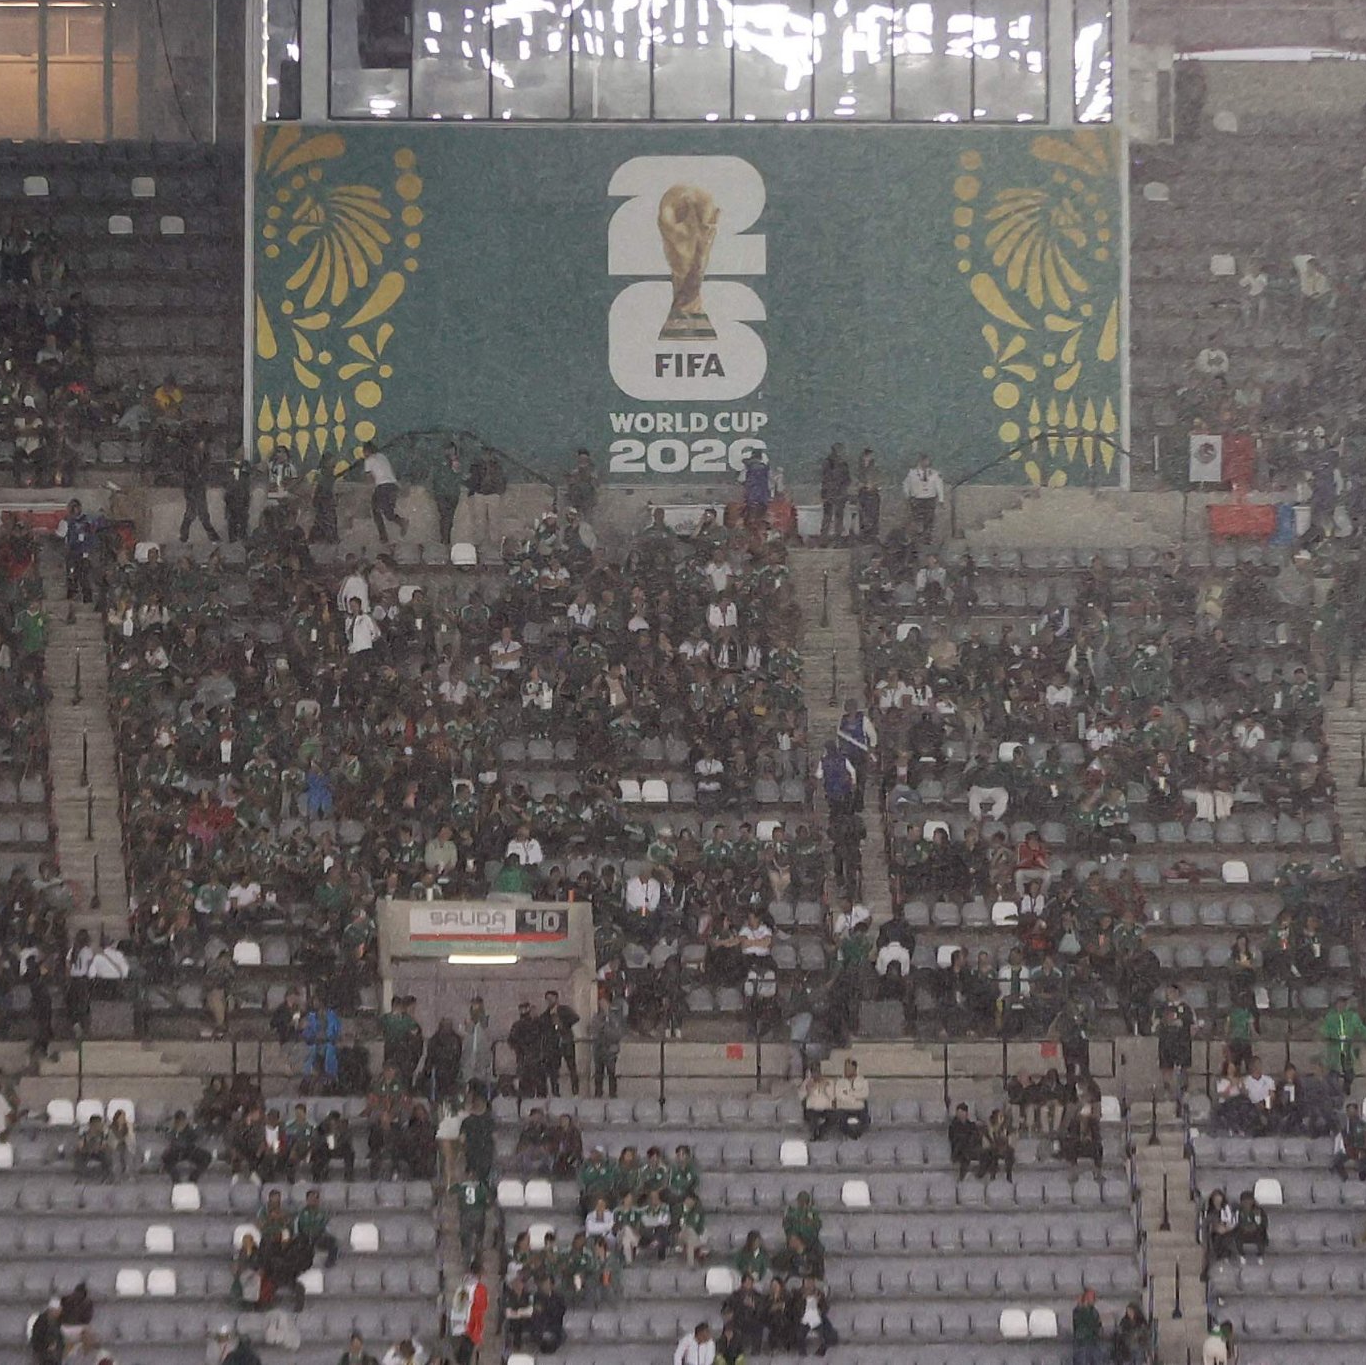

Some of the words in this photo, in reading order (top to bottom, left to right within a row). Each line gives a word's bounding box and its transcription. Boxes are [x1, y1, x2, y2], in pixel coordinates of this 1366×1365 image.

[655, 353, 725, 378] FIFA
[609, 412, 709, 434] WORLD
[713, 412, 769, 434] CUP
[429, 911, 506, 927] SALIDA
[525, 910, 561, 933] 40
